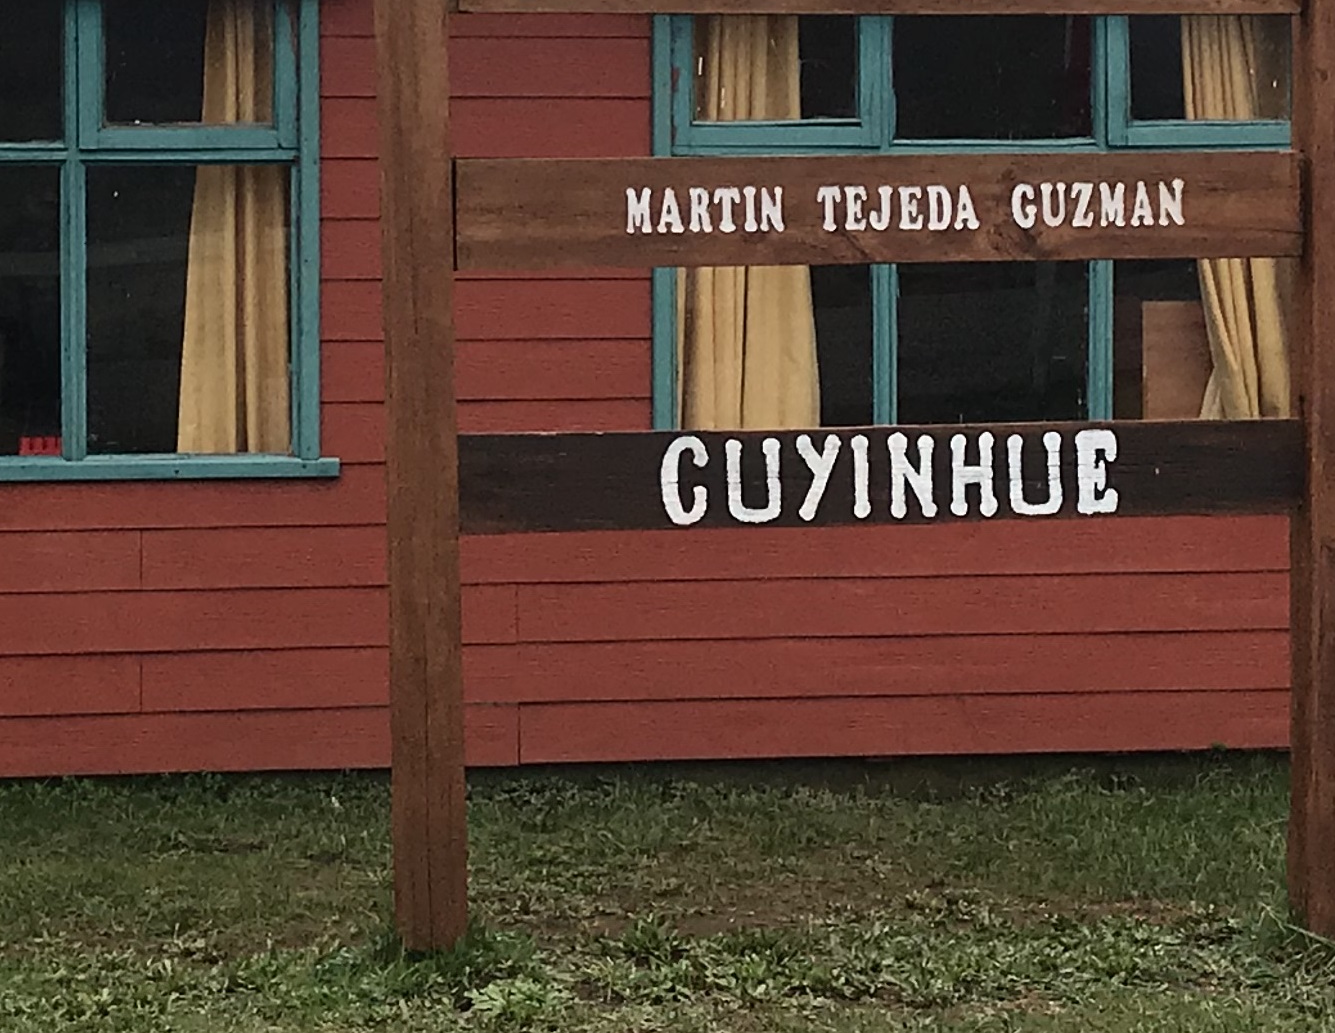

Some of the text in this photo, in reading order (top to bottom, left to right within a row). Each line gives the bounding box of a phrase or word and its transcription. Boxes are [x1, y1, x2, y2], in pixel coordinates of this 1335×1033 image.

[625, 178, 1185, 234] MARTIN TEJEDA GUZMAN
[660, 429, 1119, 525] CUYINHUE
